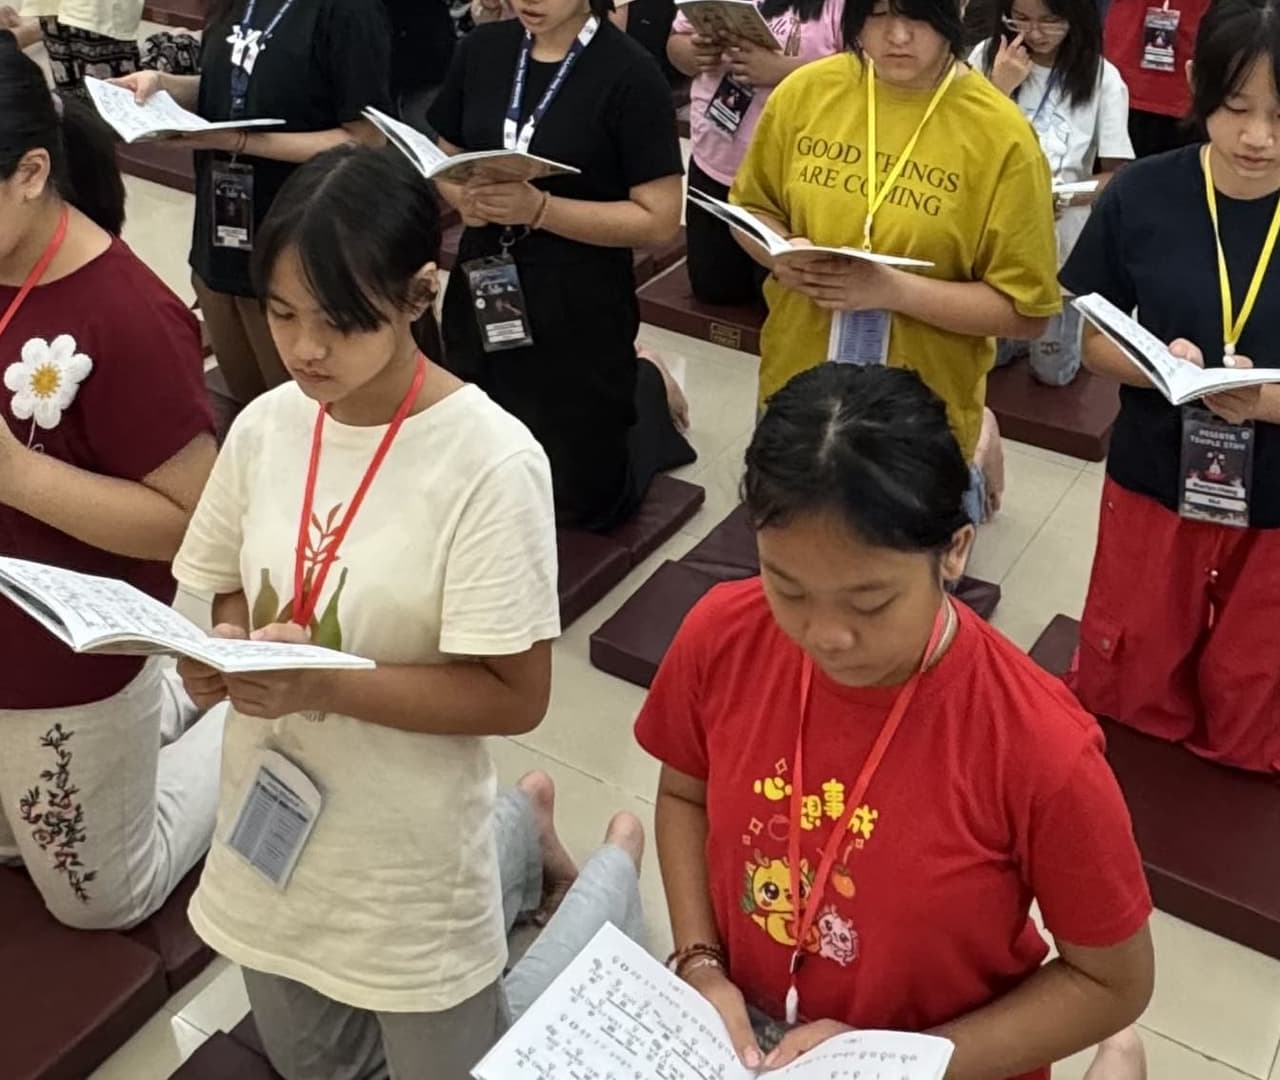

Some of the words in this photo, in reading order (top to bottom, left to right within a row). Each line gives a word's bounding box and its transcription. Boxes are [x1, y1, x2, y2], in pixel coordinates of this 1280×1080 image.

[797, 135, 862, 165] GOOD
[799, 165, 840, 189] ARE
[753, 777, 878, 839] 心想事成
